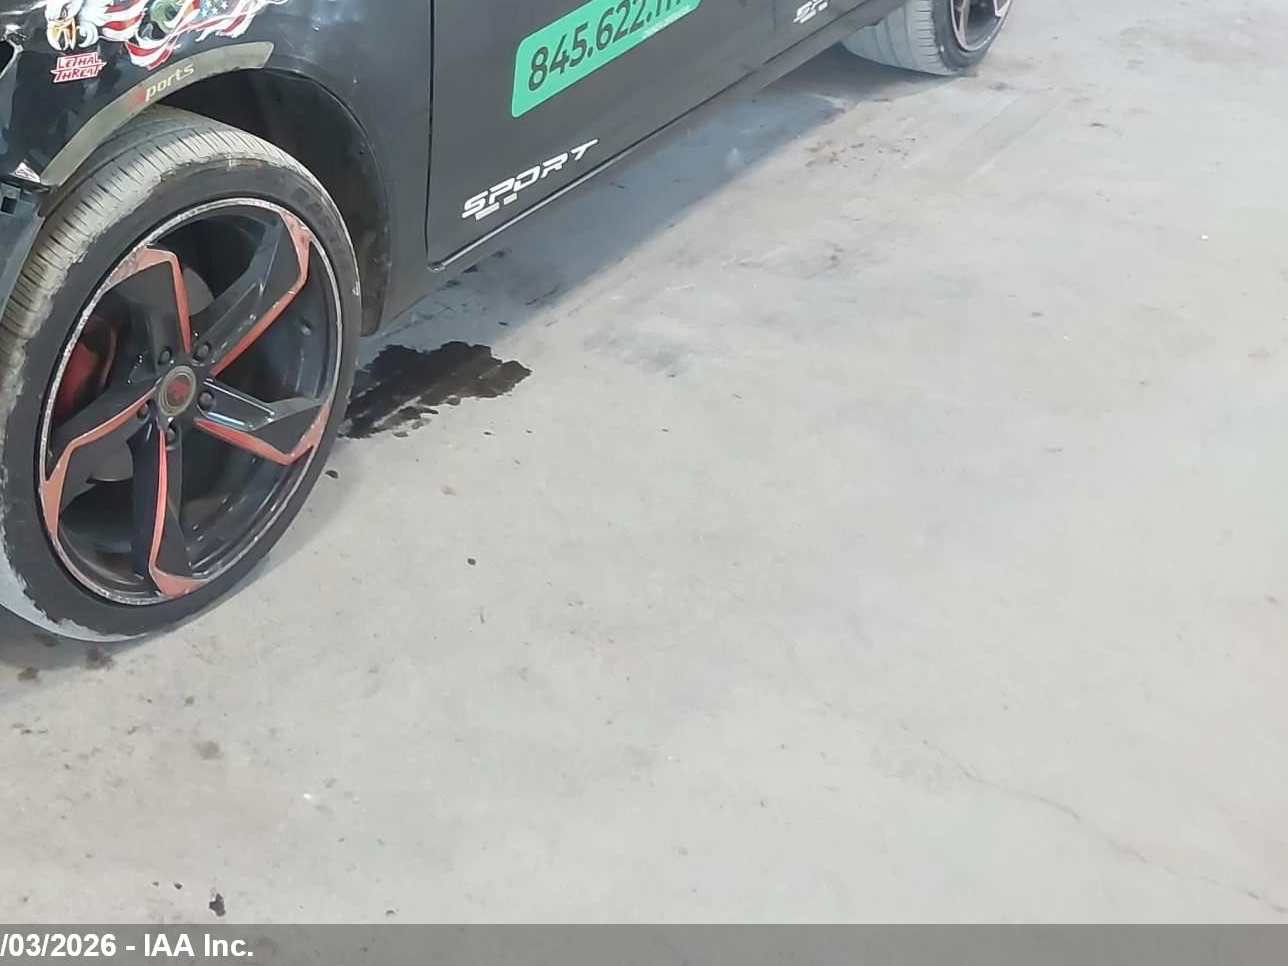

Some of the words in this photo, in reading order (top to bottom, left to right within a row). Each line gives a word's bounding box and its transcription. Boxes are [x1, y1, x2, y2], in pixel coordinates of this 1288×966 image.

[57, 55, 101, 69] LETHAL
[55, 65, 98, 81] THREAT
[461, 139, 599, 220] SPORT
